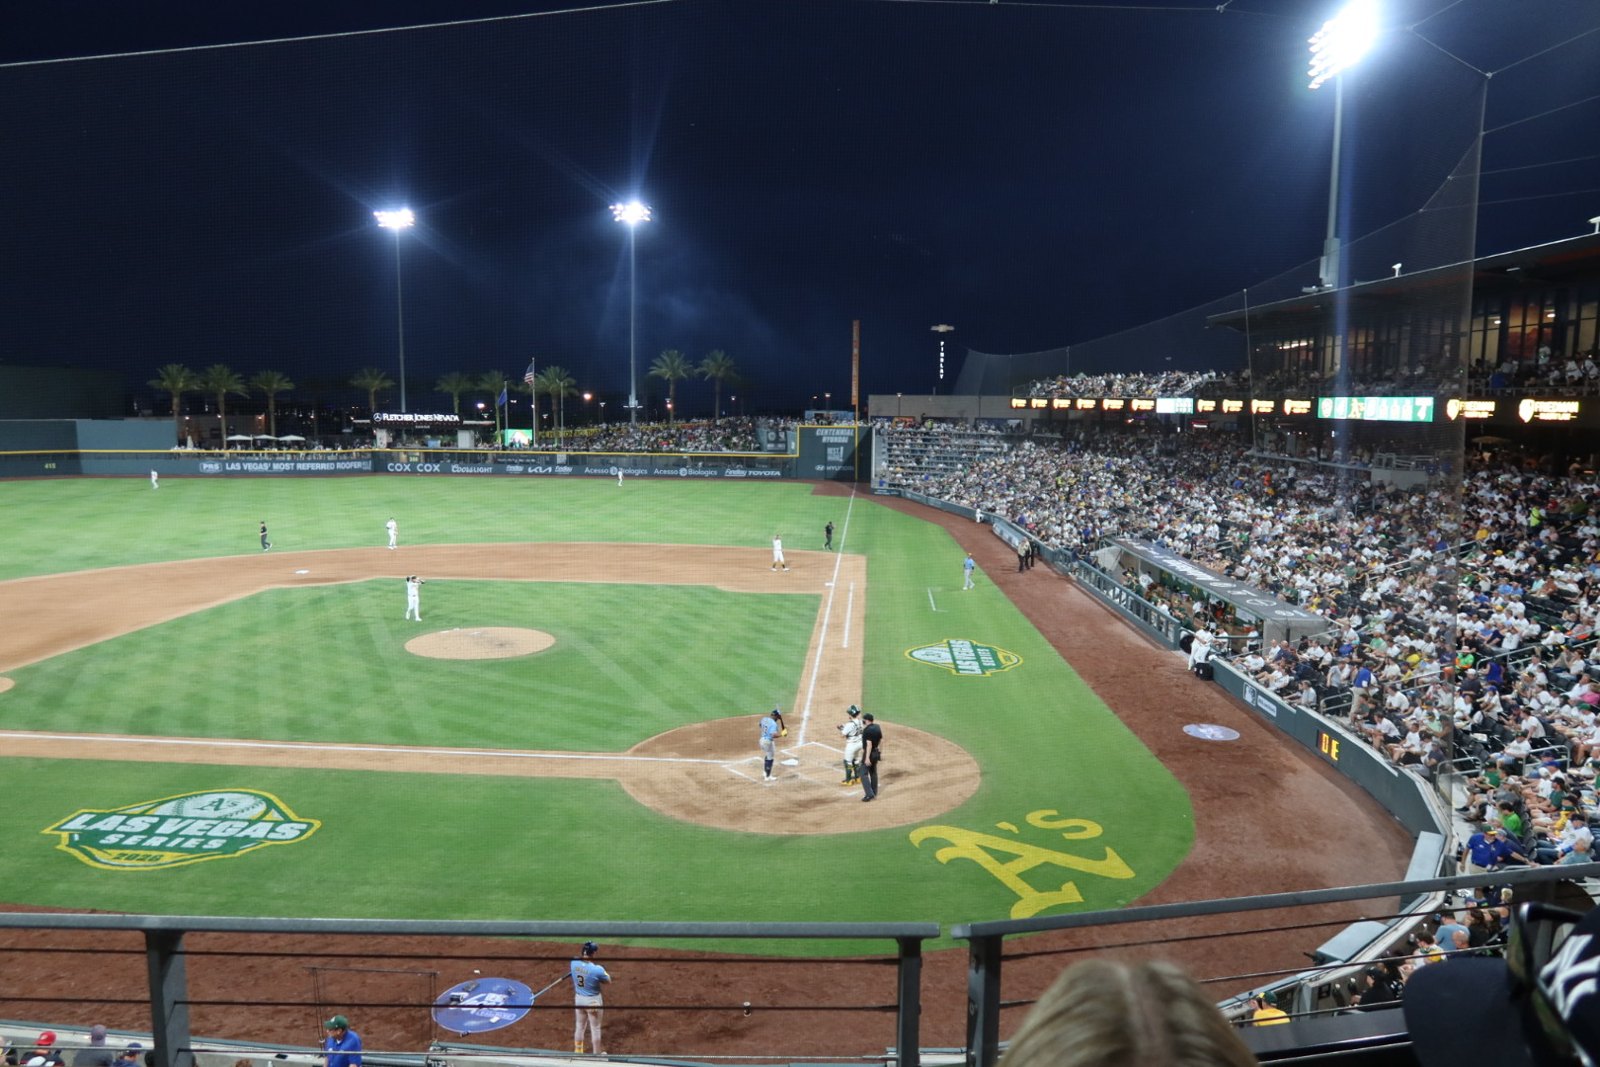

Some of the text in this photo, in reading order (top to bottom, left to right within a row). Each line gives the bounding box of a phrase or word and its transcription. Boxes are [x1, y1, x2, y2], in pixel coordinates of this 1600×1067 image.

[382, 413, 460, 422] FLETCHER JONES NEVADA
[226, 462, 241, 471] LAS
[242, 462, 271, 471] VEGAS'
[272, 462, 295, 471] MOST
[296, 462, 335, 471] REFERRED
[336, 461, 362, 470] ROOFER
[387, 463, 440, 472] COX COX
[584, 466, 609, 474] Acesso
[688, 468, 718, 477] Biologics
[60, 813, 308, 840] LAS VEGAS
[99, 833, 228, 849] SERIES
[909, 809, 1136, 920] A's
[576, 974, 585, 988] 3
